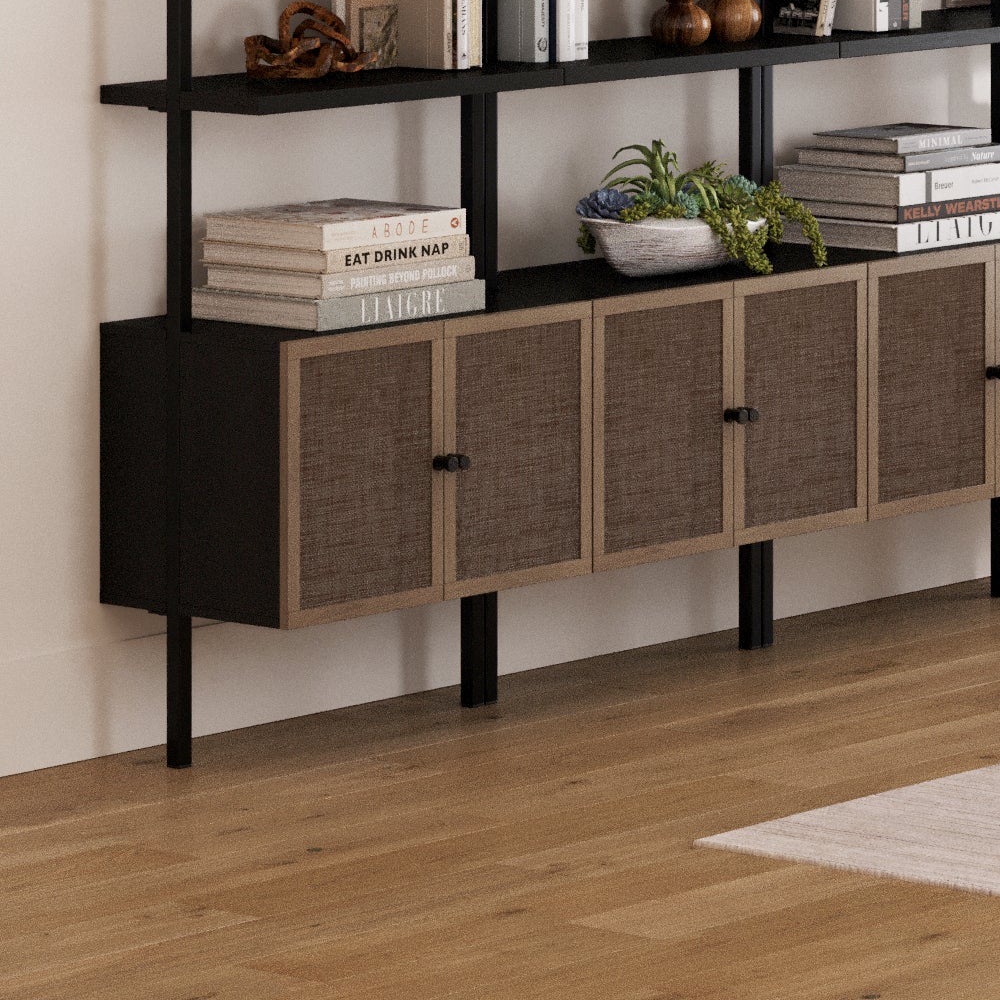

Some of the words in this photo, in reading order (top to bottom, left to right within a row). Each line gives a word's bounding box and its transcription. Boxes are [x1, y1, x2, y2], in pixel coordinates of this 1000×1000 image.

[918, 134, 963, 149] MINIMAL
[971, 151, 995, 162] Nature
[903, 204, 942, 221] KELLY
[371, 218, 430, 239] ABODE
[345, 252, 371, 267] EAT
[374, 247, 417, 263] DRINK
[421, 242, 449, 257] NAP
[350, 273, 388, 290] PAINTING
[389, 269, 421, 284] BEYOND
[422, 264, 458, 280] POLLOCK
[361, 288, 446, 324] LIAIGRE
